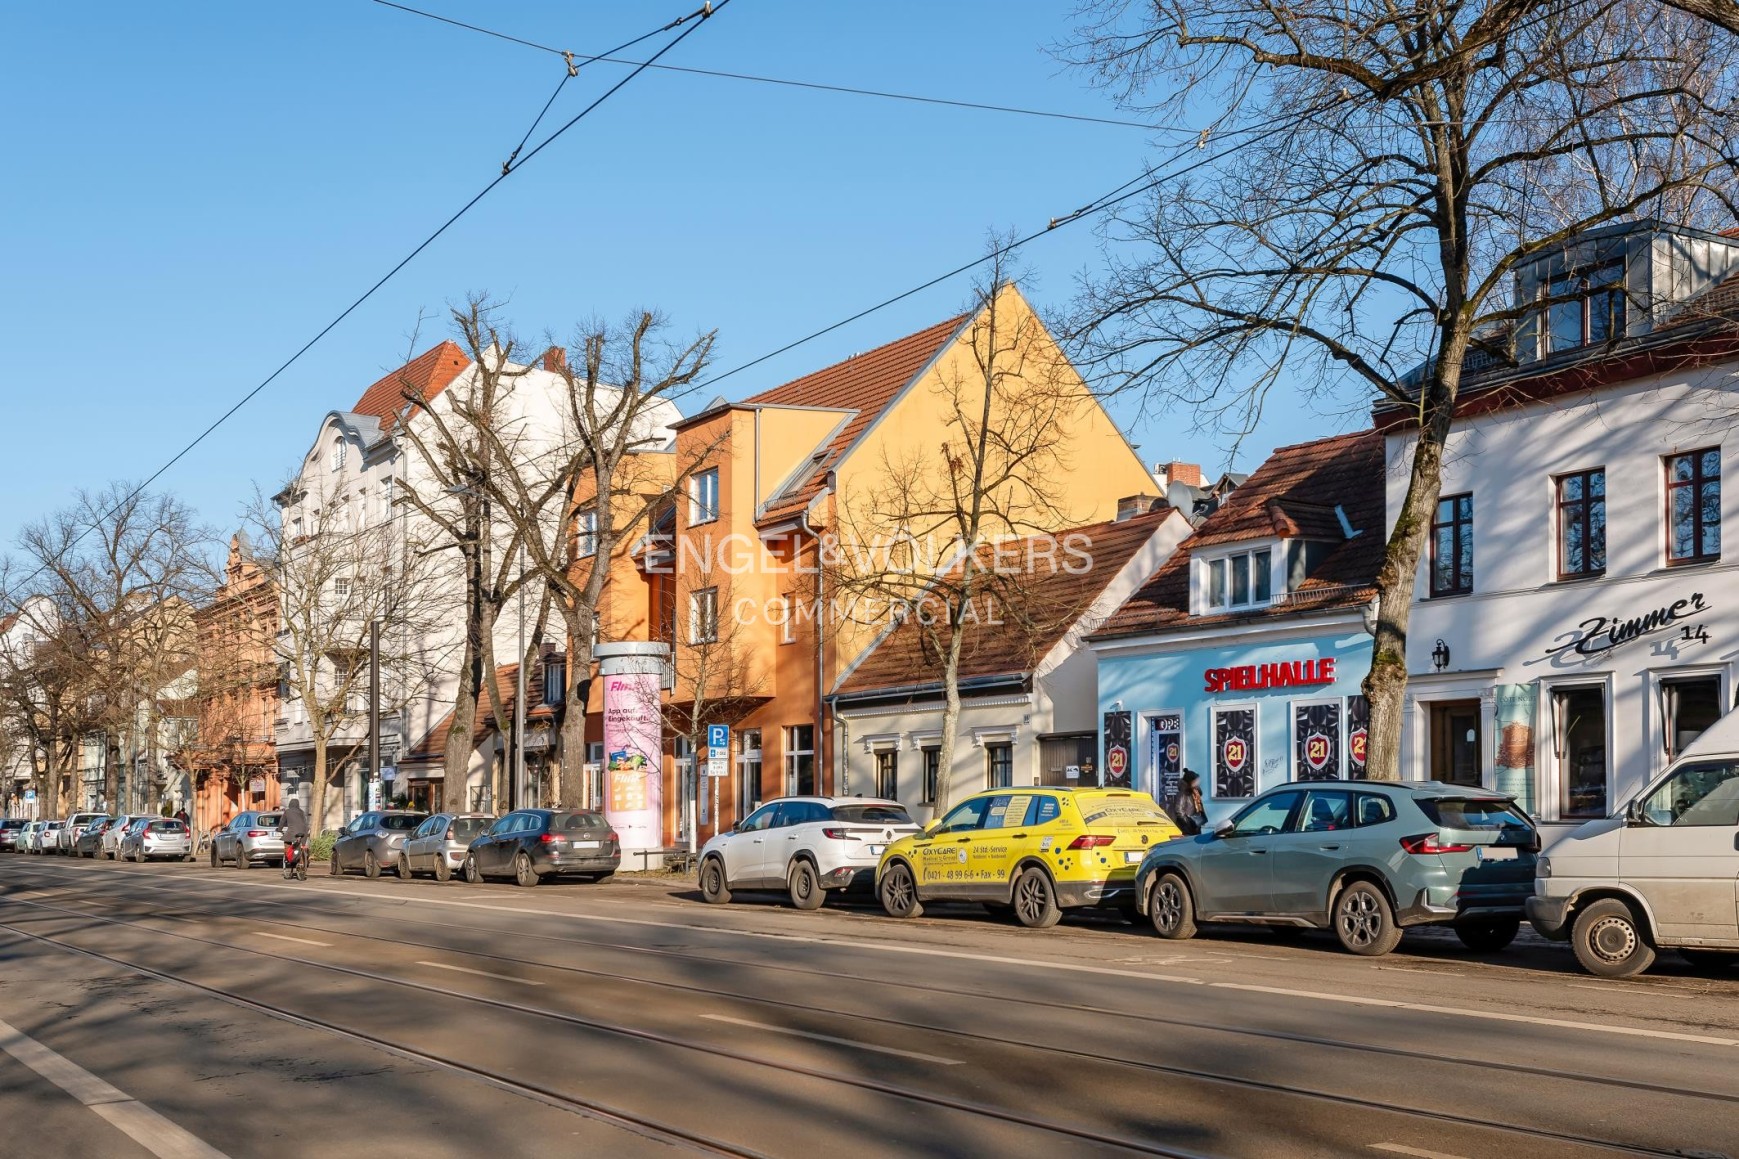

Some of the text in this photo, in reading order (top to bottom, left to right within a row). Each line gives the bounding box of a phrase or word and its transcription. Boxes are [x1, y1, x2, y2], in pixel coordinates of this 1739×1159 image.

[1545, 592, 1712, 655] Zimmer
[1681, 624, 1709, 644] 14
[1204, 657, 1337, 692] SPIELHALLE
[712, 727, 725, 745] P
[1168, 747, 1177, 757] 21
[1228, 744, 1242, 761] 21
[1309, 741, 1325, 758] 21
[1111, 752, 1124, 768] 21
[946, 869, 954, 879] 48
[980, 869, 991, 879] Fax
[996, 868, 1005, 879] 99
